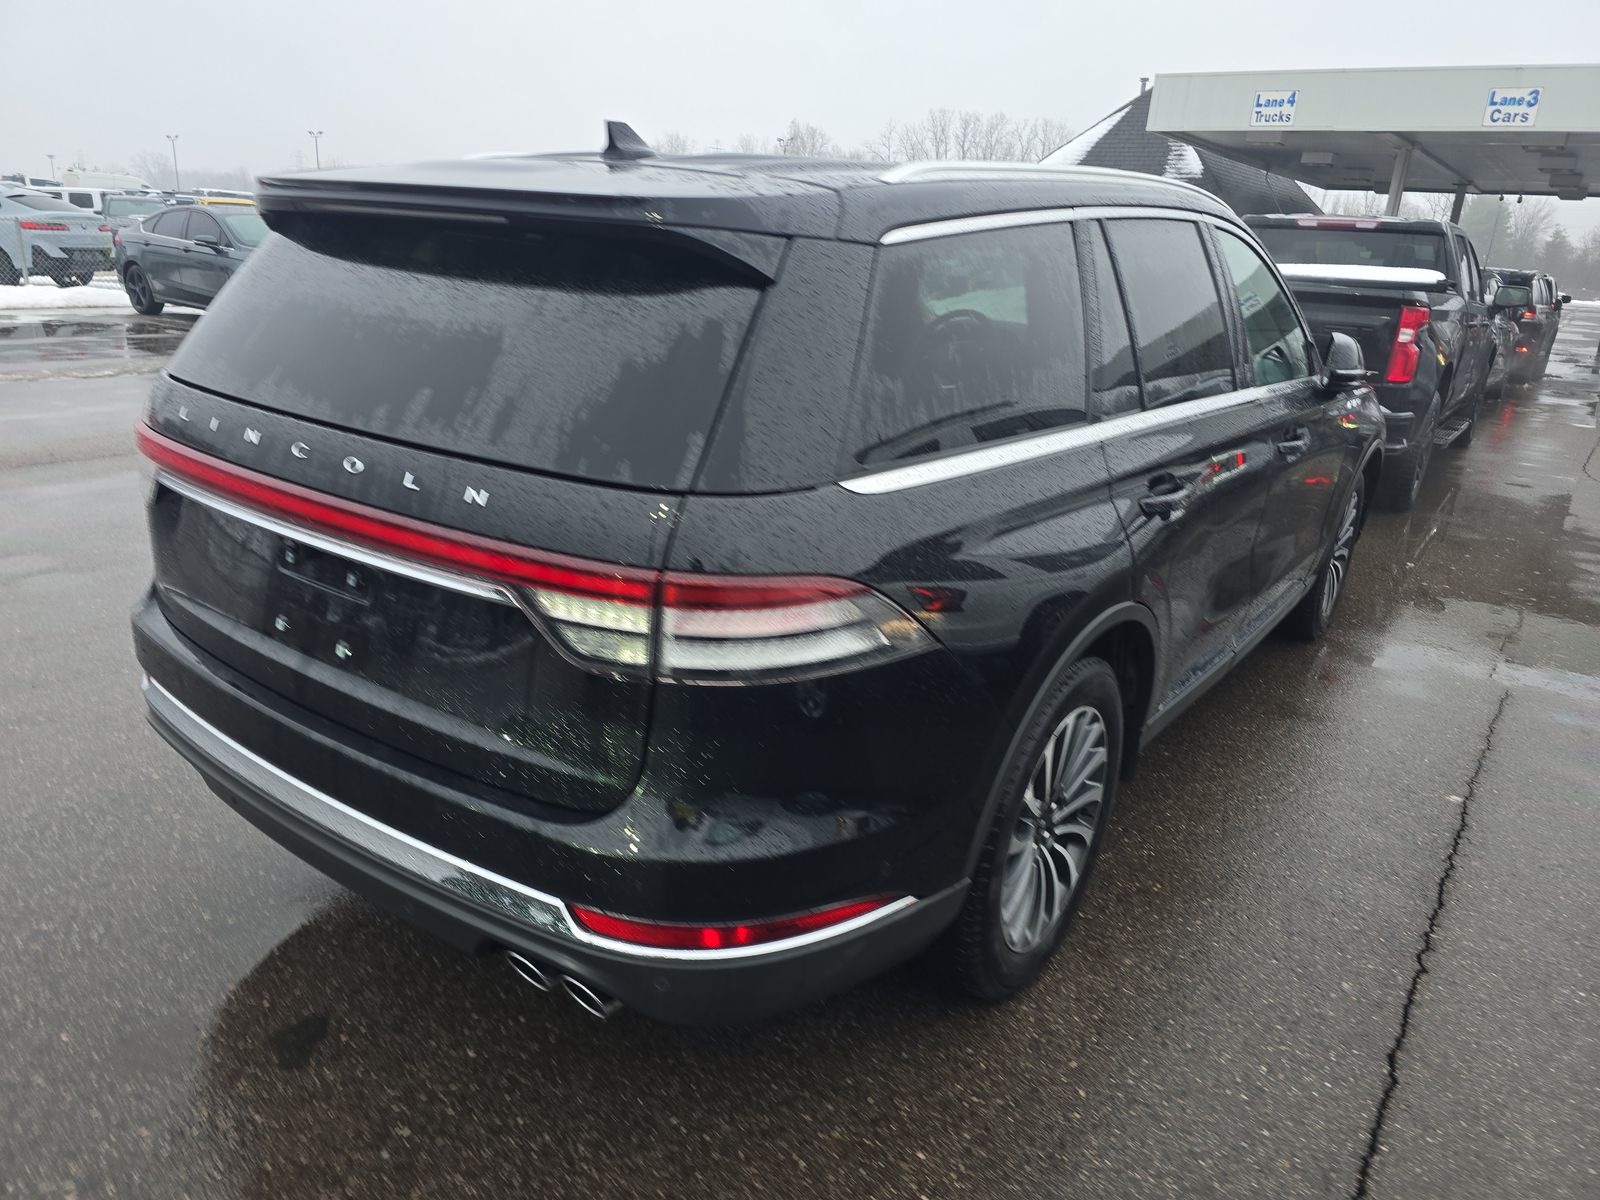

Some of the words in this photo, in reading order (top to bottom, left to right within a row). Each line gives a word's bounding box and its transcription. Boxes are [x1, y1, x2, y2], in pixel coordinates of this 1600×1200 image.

[1255, 94, 1285, 108] Lane
[1287, 90, 1297, 107] 4
[1488, 90, 1525, 106] Lane
[1526, 89, 1540, 108] 3
[1255, 110, 1292, 123] Trucks
[1490, 108, 1529, 123] Cars
[179, 406, 490, 507] LINCOLN
